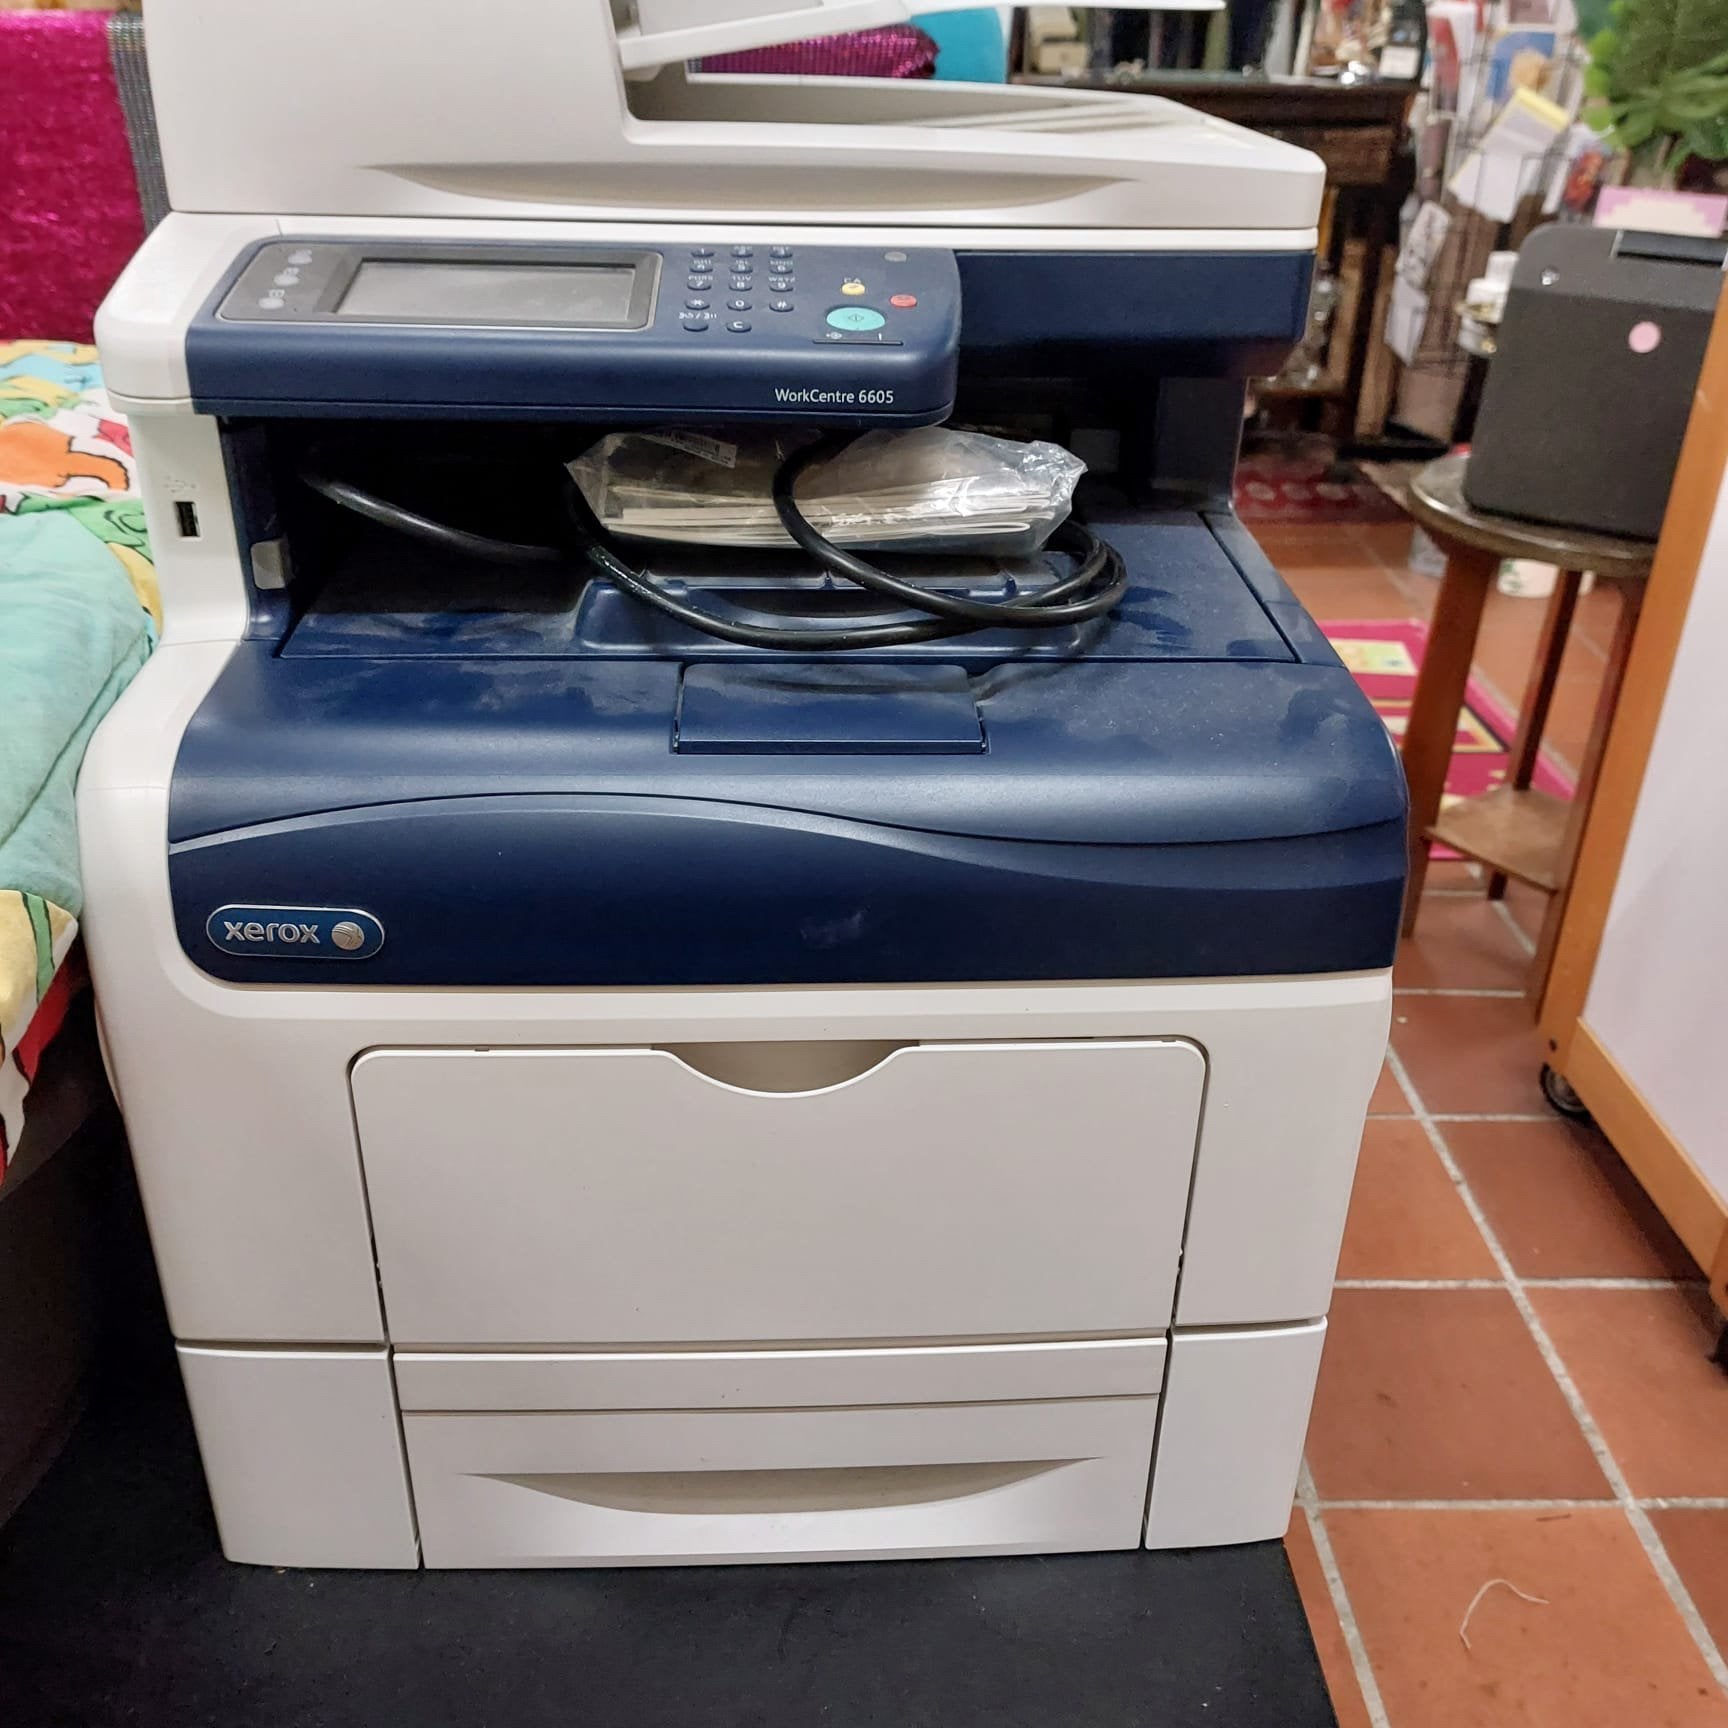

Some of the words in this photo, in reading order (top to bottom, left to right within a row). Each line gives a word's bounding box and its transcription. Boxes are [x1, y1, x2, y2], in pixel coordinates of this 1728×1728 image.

[774, 387, 855, 404] WorkCentre
[857, 389, 895, 404] 6605
[223, 920, 321, 945] xerox
